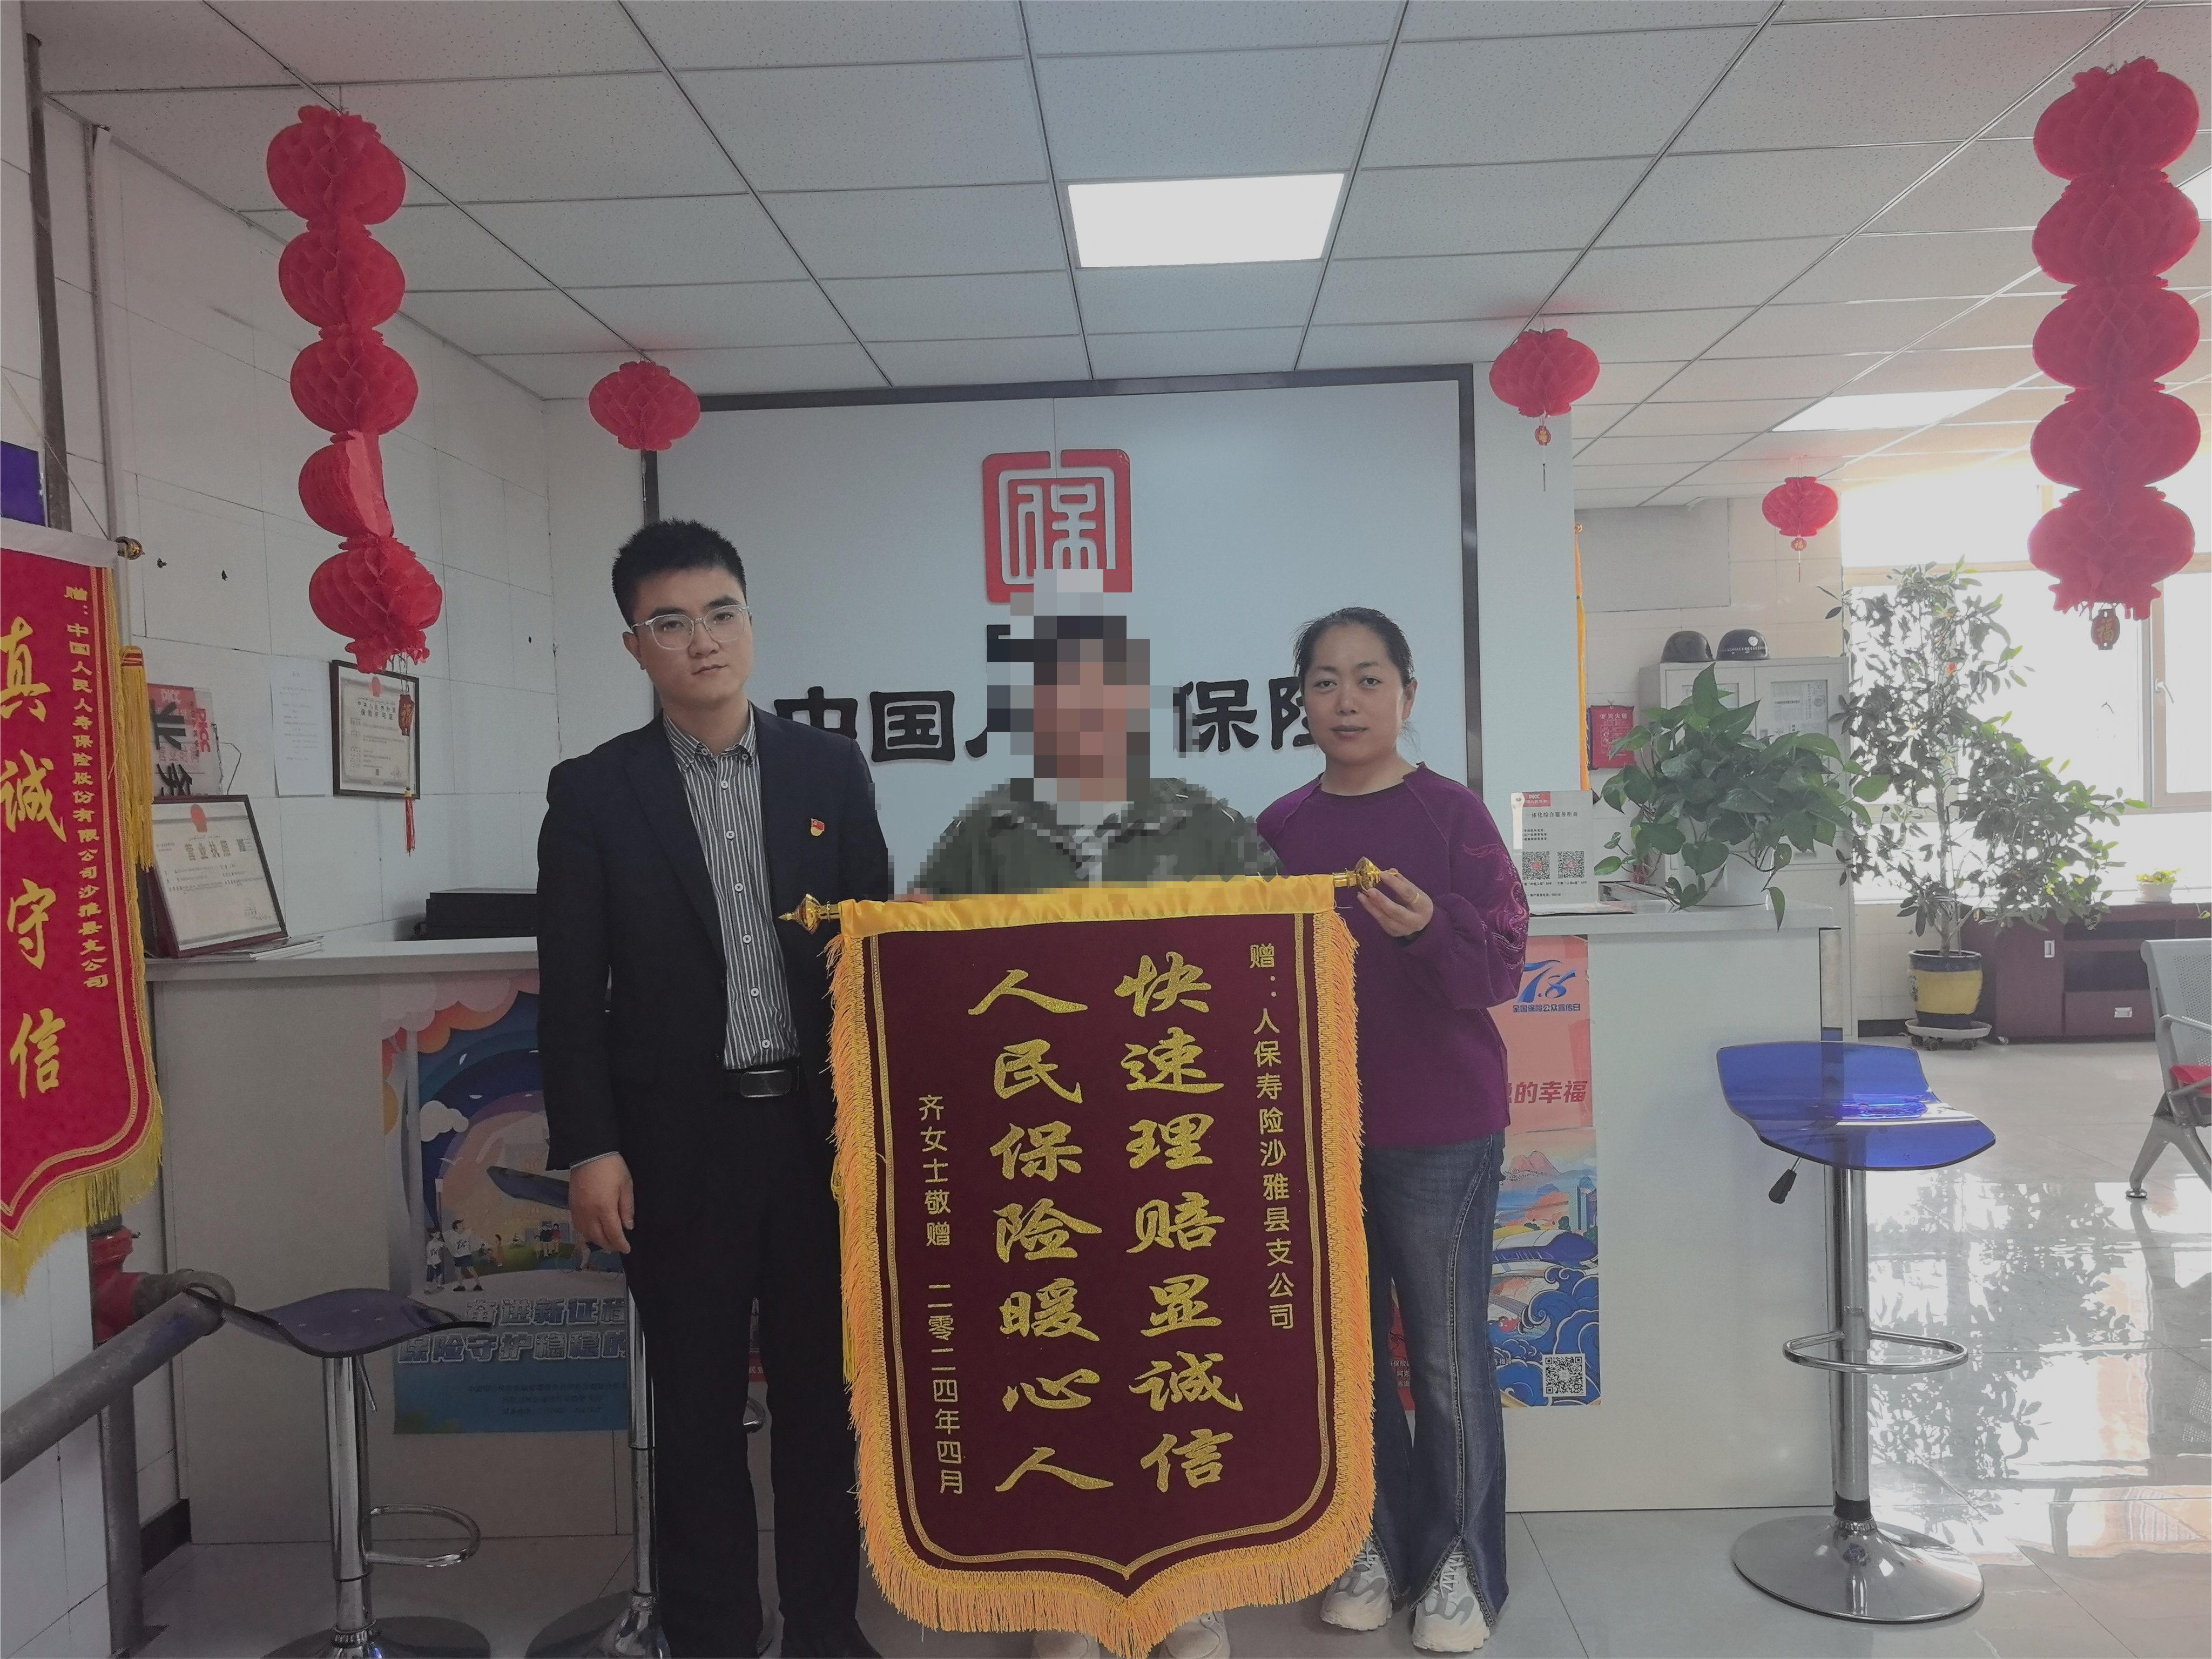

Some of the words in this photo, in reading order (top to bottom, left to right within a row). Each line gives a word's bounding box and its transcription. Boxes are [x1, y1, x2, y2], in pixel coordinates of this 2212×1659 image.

[2096, 617, 2115, 642] 福
[0, 615, 66, 1098] 真诚守信
[1513, 1003, 1580, 1013] 全国保险公众宣传日
[1518, 959, 1576, 1003] 7.8
[919, 1094, 952, 1247] 齐女士敬赠
[968, 969, 1114, 1492] 人民保险暖心人
[1114, 950, 1243, 1493] 快速理赔显诚信
[928, 1283, 964, 1495] 二零二四年四月
